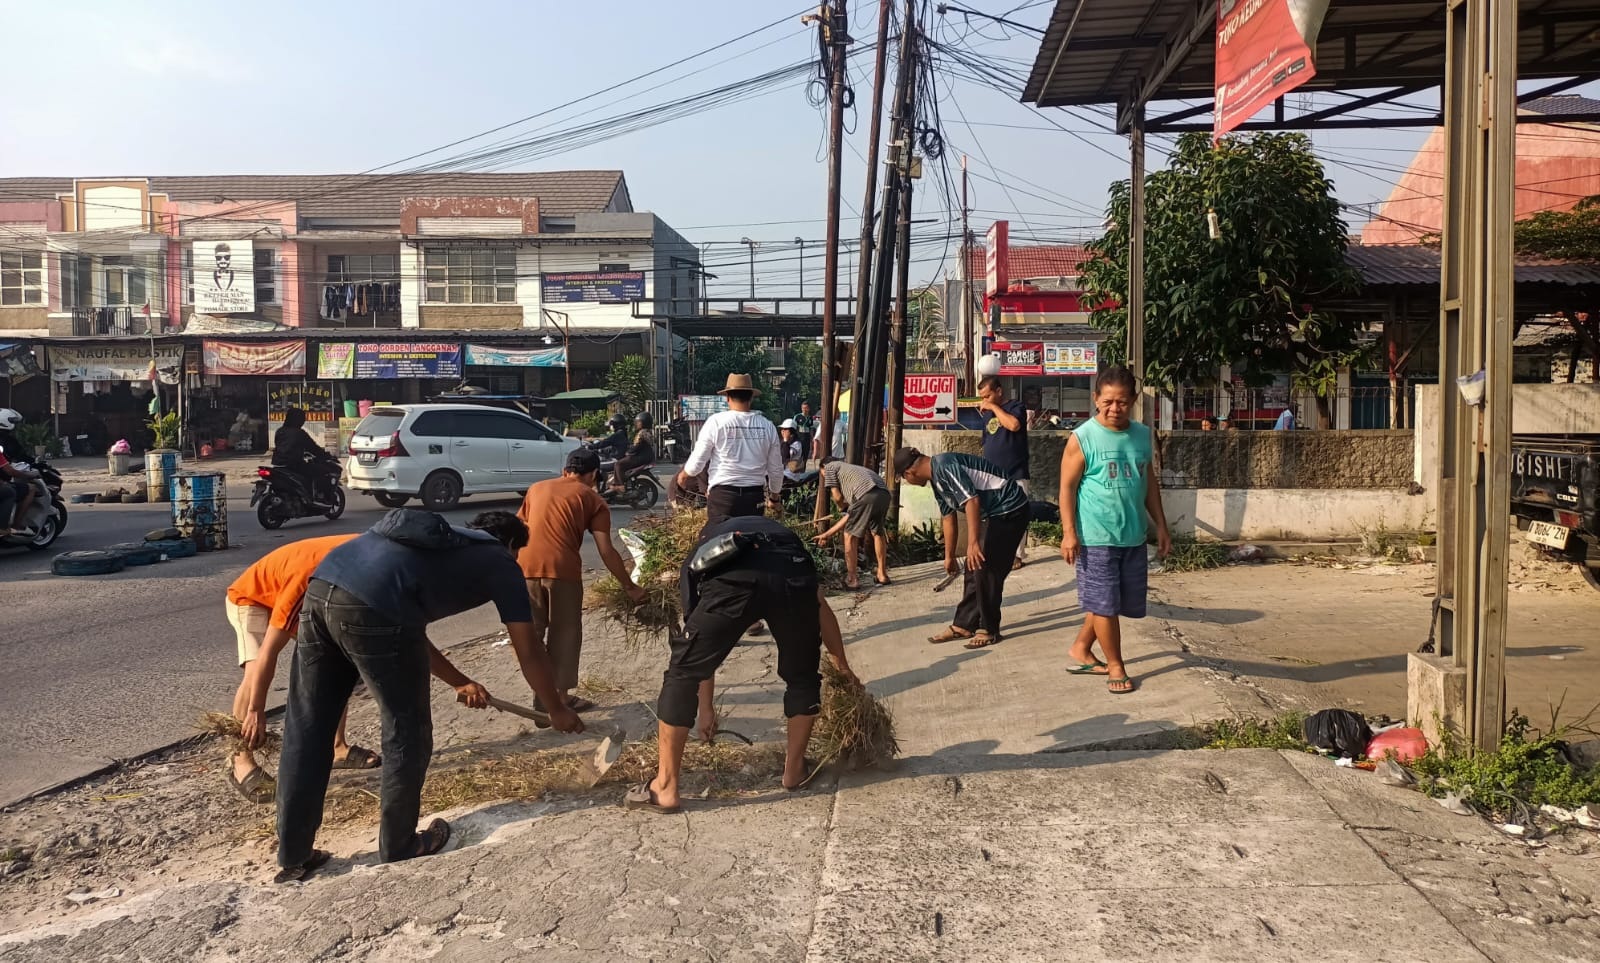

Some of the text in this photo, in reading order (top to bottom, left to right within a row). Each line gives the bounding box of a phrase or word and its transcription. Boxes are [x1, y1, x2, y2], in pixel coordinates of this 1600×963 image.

[357, 343, 379, 353] TOKO
[379, 343, 411, 353] GORDEN
[411, 343, 459, 353] LANGGANAN
[76, 348, 126, 359] NAUFAL
[130, 347, 180, 358] PLASTIK
[1007, 356, 1036, 364] GRATIS
[1557, 493, 1579, 502] COLT
